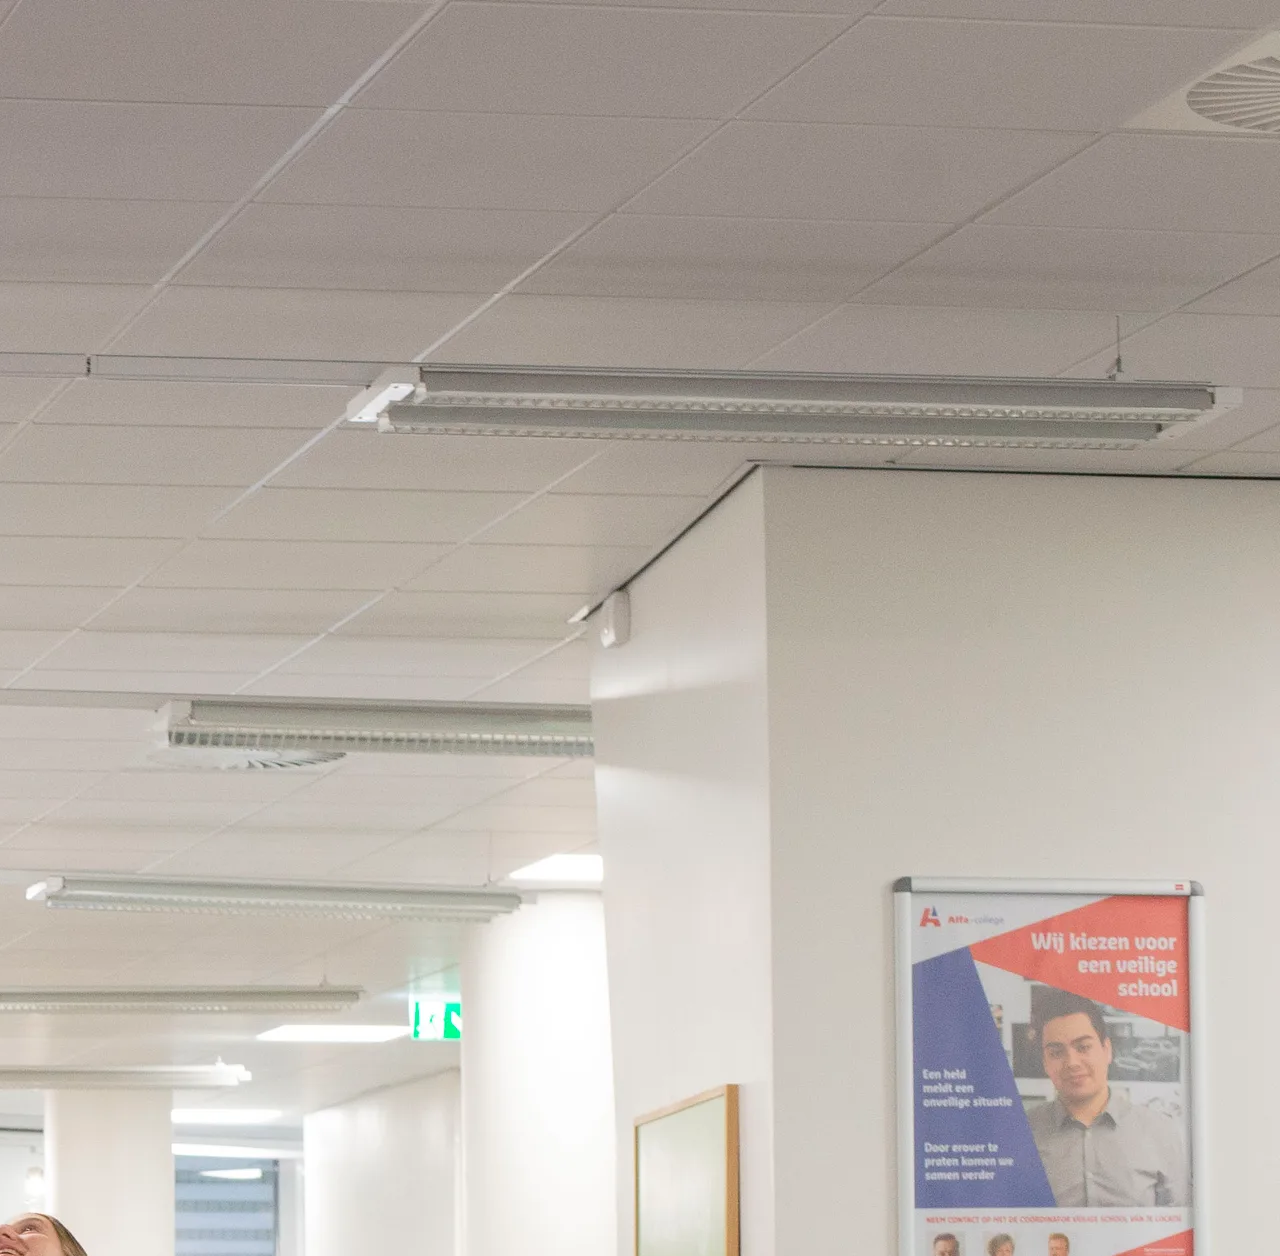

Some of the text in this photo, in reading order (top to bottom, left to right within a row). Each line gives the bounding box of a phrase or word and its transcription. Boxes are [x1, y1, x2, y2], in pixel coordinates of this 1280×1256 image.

[1030, 931, 1177, 954] Wij kiezen voor
[1077, 955, 1178, 977] een veilige
[1117, 979, 1178, 997] school
[922, 1068, 967, 1080] Een held
[922, 1083, 974, 1094] meldt een
[922, 1096, 1013, 1109] onveilige situatie
[923, 1142, 998, 1153] Door erover te
[924, 1156, 1015, 1169] praten komen we
[924, 1170, 995, 1180] samen verder
